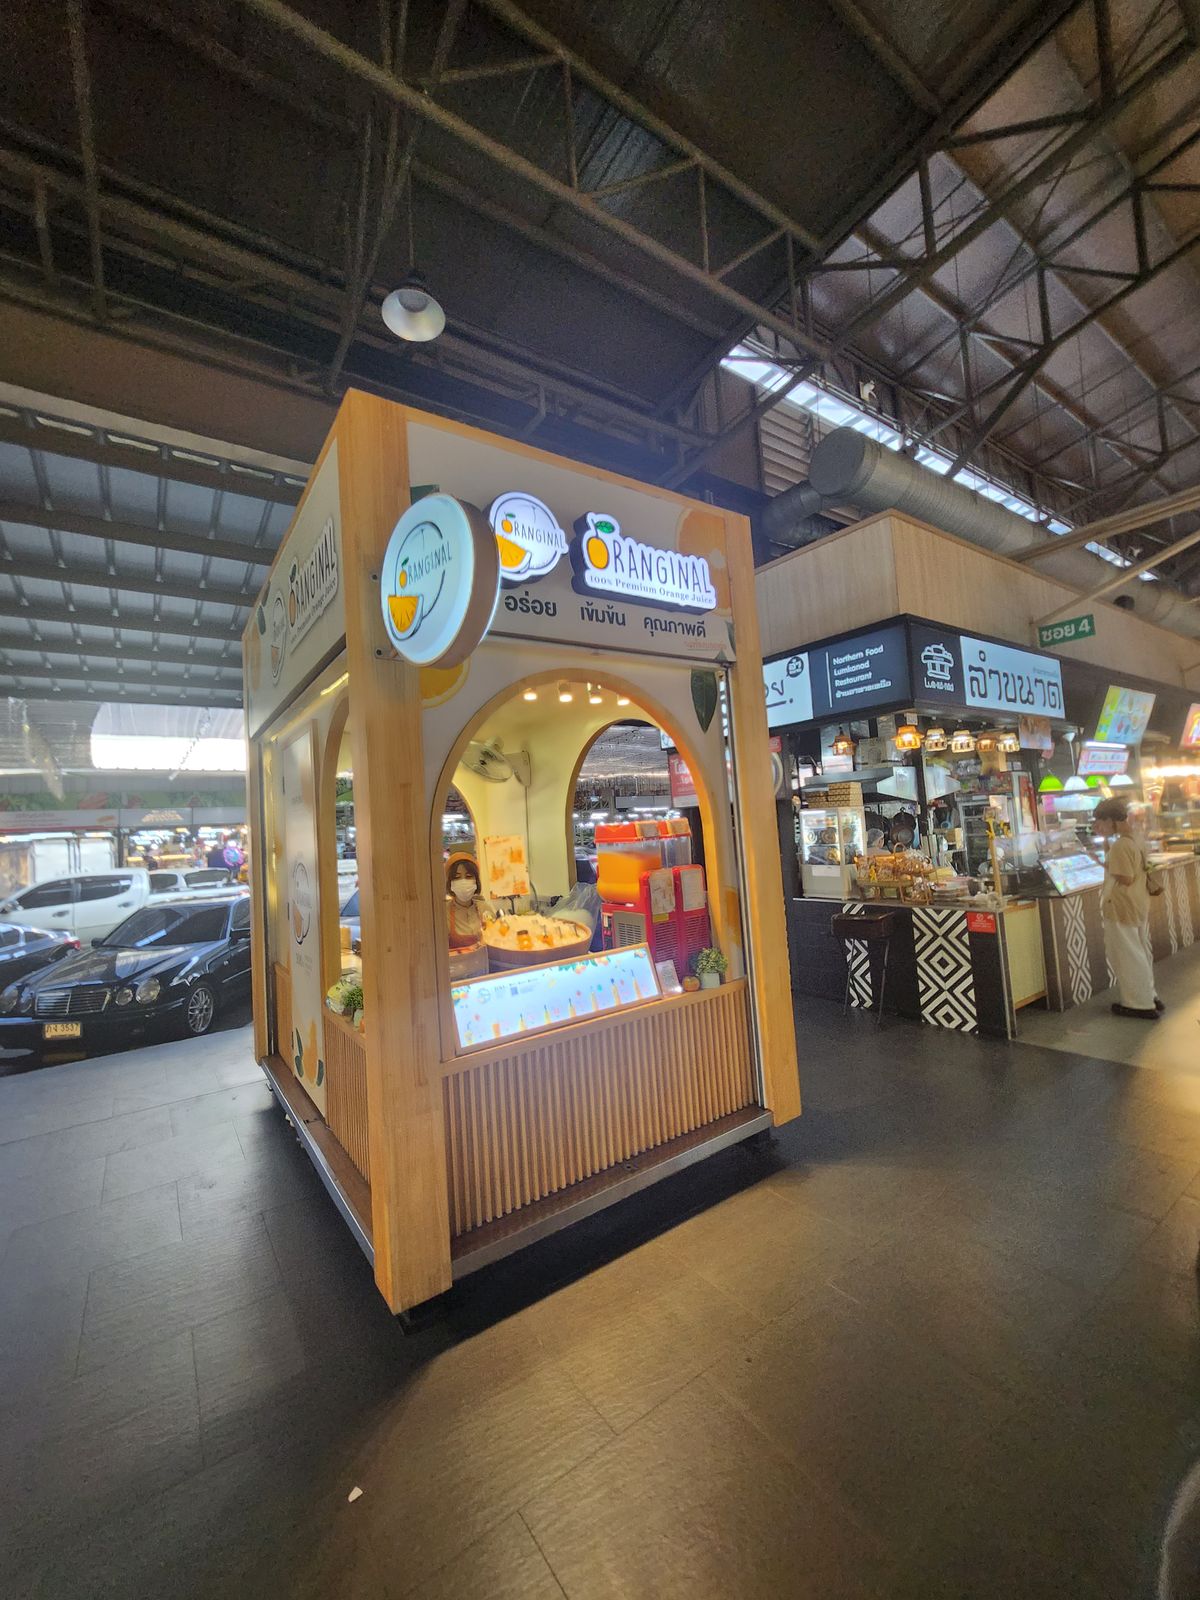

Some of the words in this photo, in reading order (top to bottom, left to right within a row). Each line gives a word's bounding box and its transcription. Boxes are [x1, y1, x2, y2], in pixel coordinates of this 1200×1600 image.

[616, 578, 656, 595] Premium
[659, 586, 690, 601] Orange
[692, 592, 713, 605] Juice
[505, 591, 557, 617] อร่อย
[580, 601, 626, 627] เข้มข้น
[643, 616, 706, 638] คุณภาพดี
[1079, 618, 1090, 633] 4
[833, 651, 864, 665] Northern
[865, 644, 884, 656] Food
[835, 671, 872, 687] Restaurant
